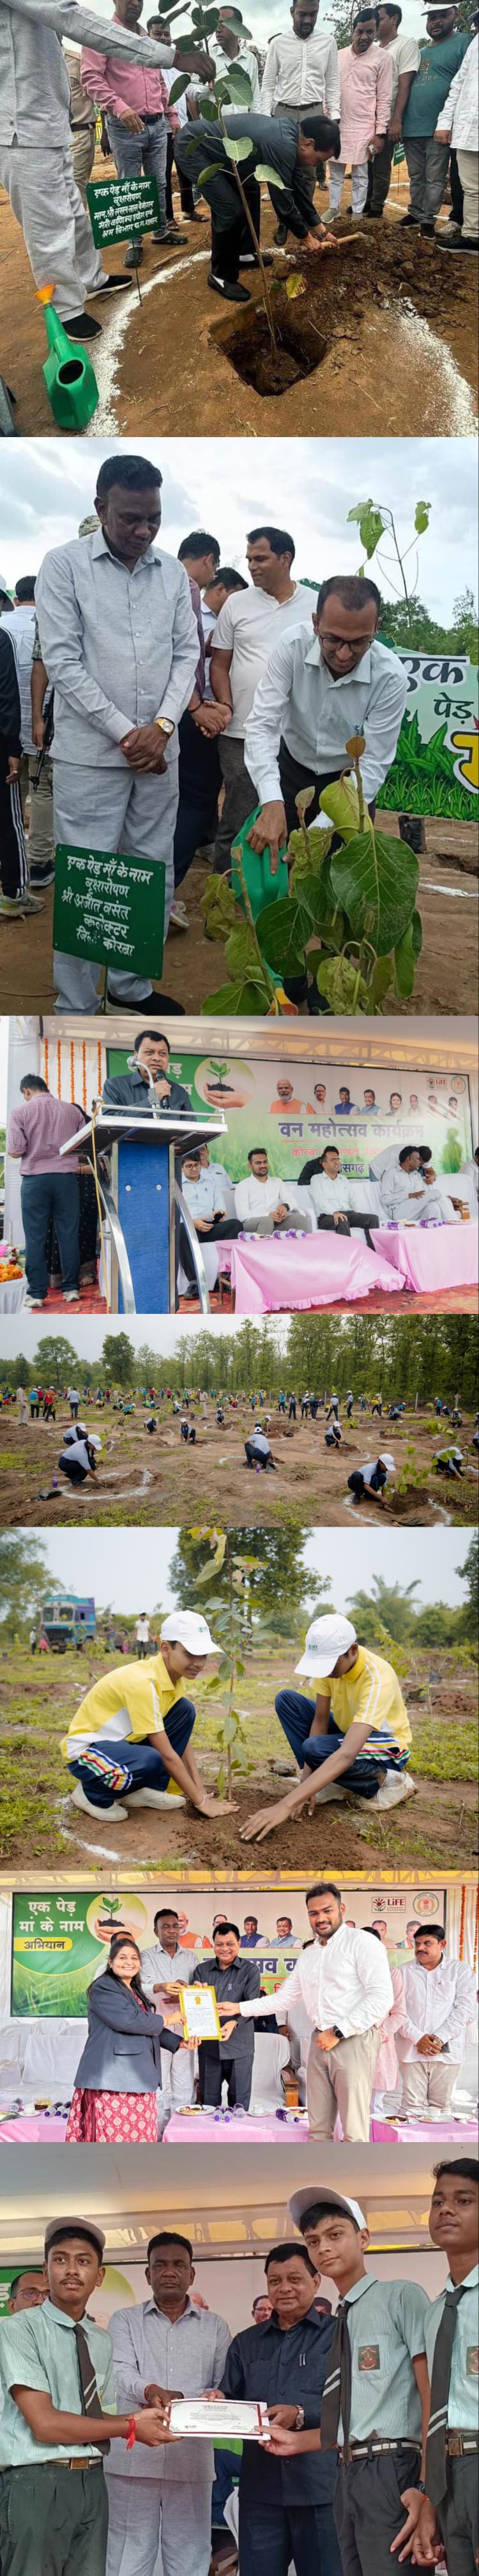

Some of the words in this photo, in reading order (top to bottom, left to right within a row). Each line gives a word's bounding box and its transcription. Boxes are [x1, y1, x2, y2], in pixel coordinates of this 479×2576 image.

[93, 188, 109, 199] एक
[121, 181, 131, 193] माँ
[130, 181, 139, 191] के
[138, 181, 151, 190] नाम
[113, 192, 142, 206] वृक्षारोपण
[128, 204, 139, 213] लाल
[110, 215, 132, 226] वाणिज्य
[102, 229, 114, 238] श्रम
[115, 224, 134, 234] विभाग
[434, 692, 474, 725] पेड़
[67, 856, 87, 871] एक
[103, 858, 118, 877] माँ
[117, 862, 129, 877] के
[129, 867, 153, 884] नाम
[84, 877, 130, 898] वृक्षारोपण
[61, 886, 74, 904] श्री
[103, 900, 132, 920] वसंत
[84, 913, 130, 939] कलेक्टर
[103, 936, 135, 956] कोरबा
[278, 1122, 303, 1138] वन
[308, 1118, 367, 1138] महोत्सव
[371, 1120, 424, 1138] कार्यक्रम
[291, 1146, 318, 1156] कोरबा
[28, 1901, 51, 1915] एक
[56, 1897, 76, 1917] पेड़
[19, 1917, 35, 1932] मां
[40, 1917, 54, 1932] के
[59, 1920, 85, 1932] नाम
[24, 1938, 66, 1950] अभियान
